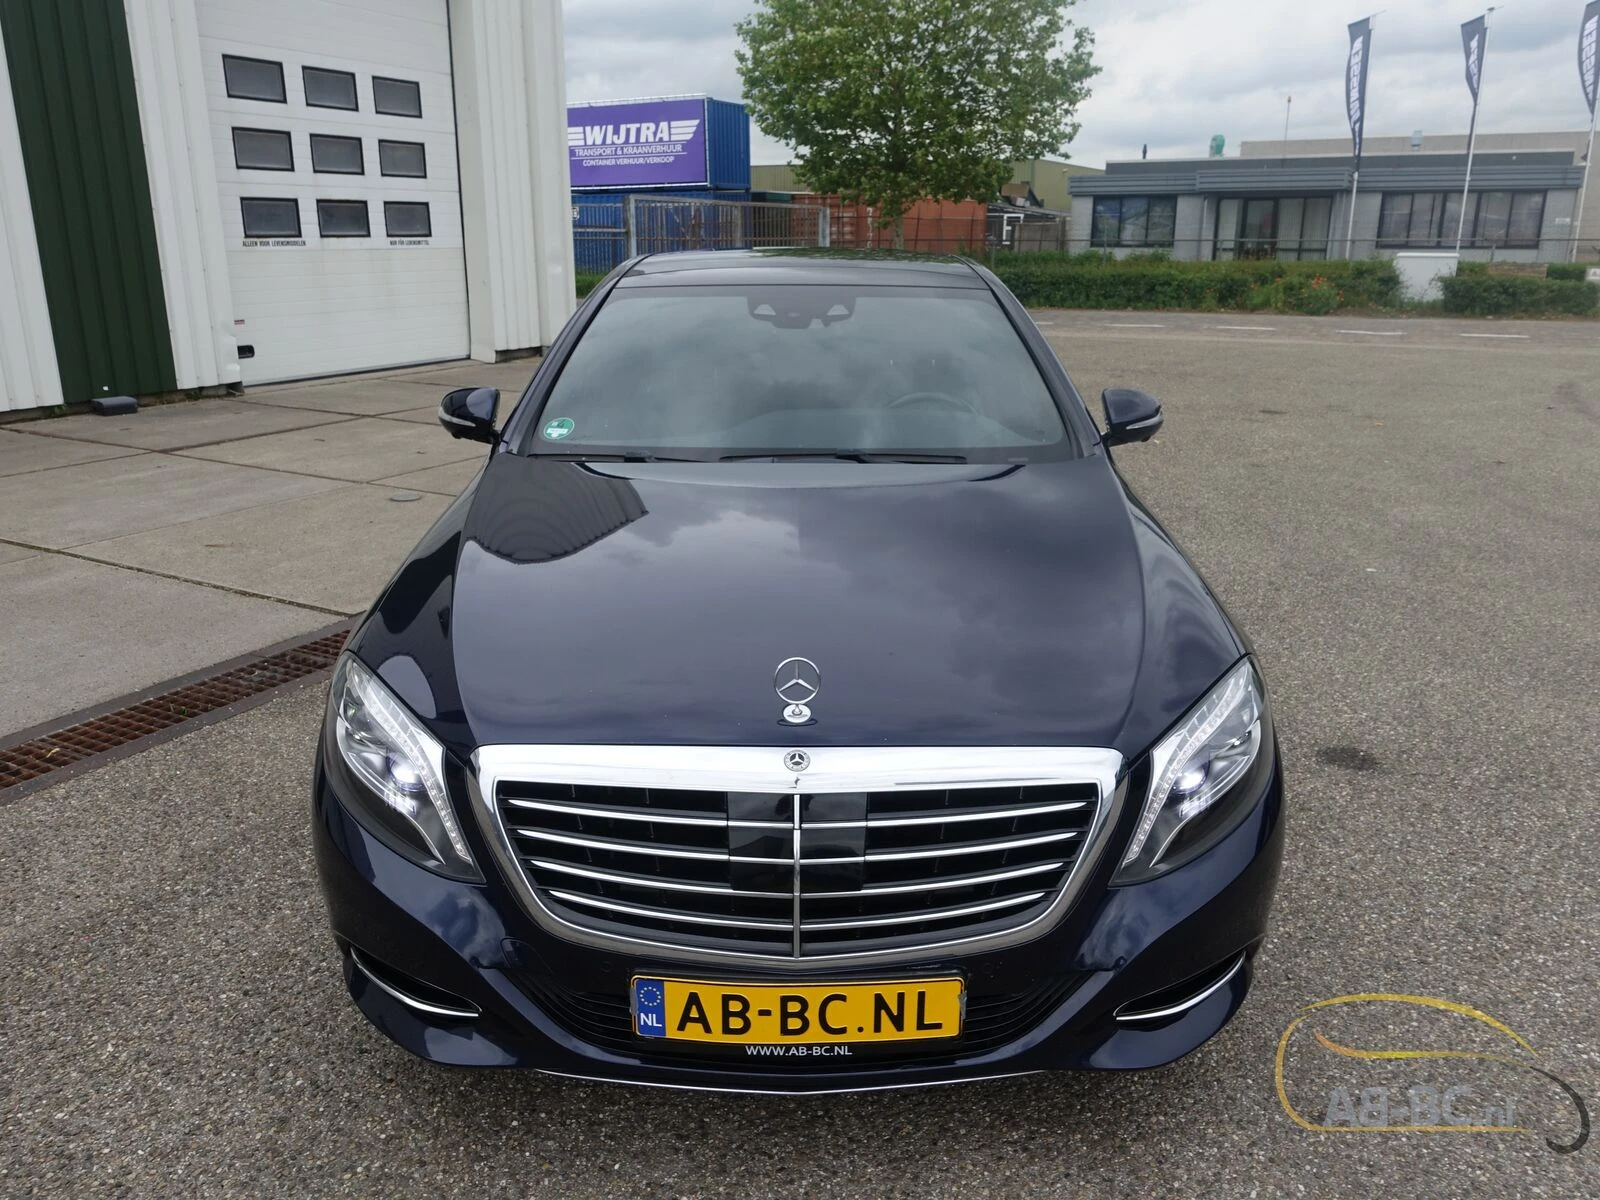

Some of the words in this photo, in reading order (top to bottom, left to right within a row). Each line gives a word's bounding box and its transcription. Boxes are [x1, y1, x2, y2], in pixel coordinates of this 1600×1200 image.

[585, 121, 670, 145] WIJTRA
[575, 147, 615, 156] TRANSPORT
[617, 147, 622, 155] &
[623, 144, 683, 155] KRAANVERHUUR
[583, 158, 615, 167] CONTAINER
[616, 156, 675, 165] VERHUUR/VERKOOP
[639, 1012, 662, 1028] NL
[676, 990, 943, 1036] AB-BC.NL
[745, 1045, 853, 1056] WWW.AB-BC.NL
